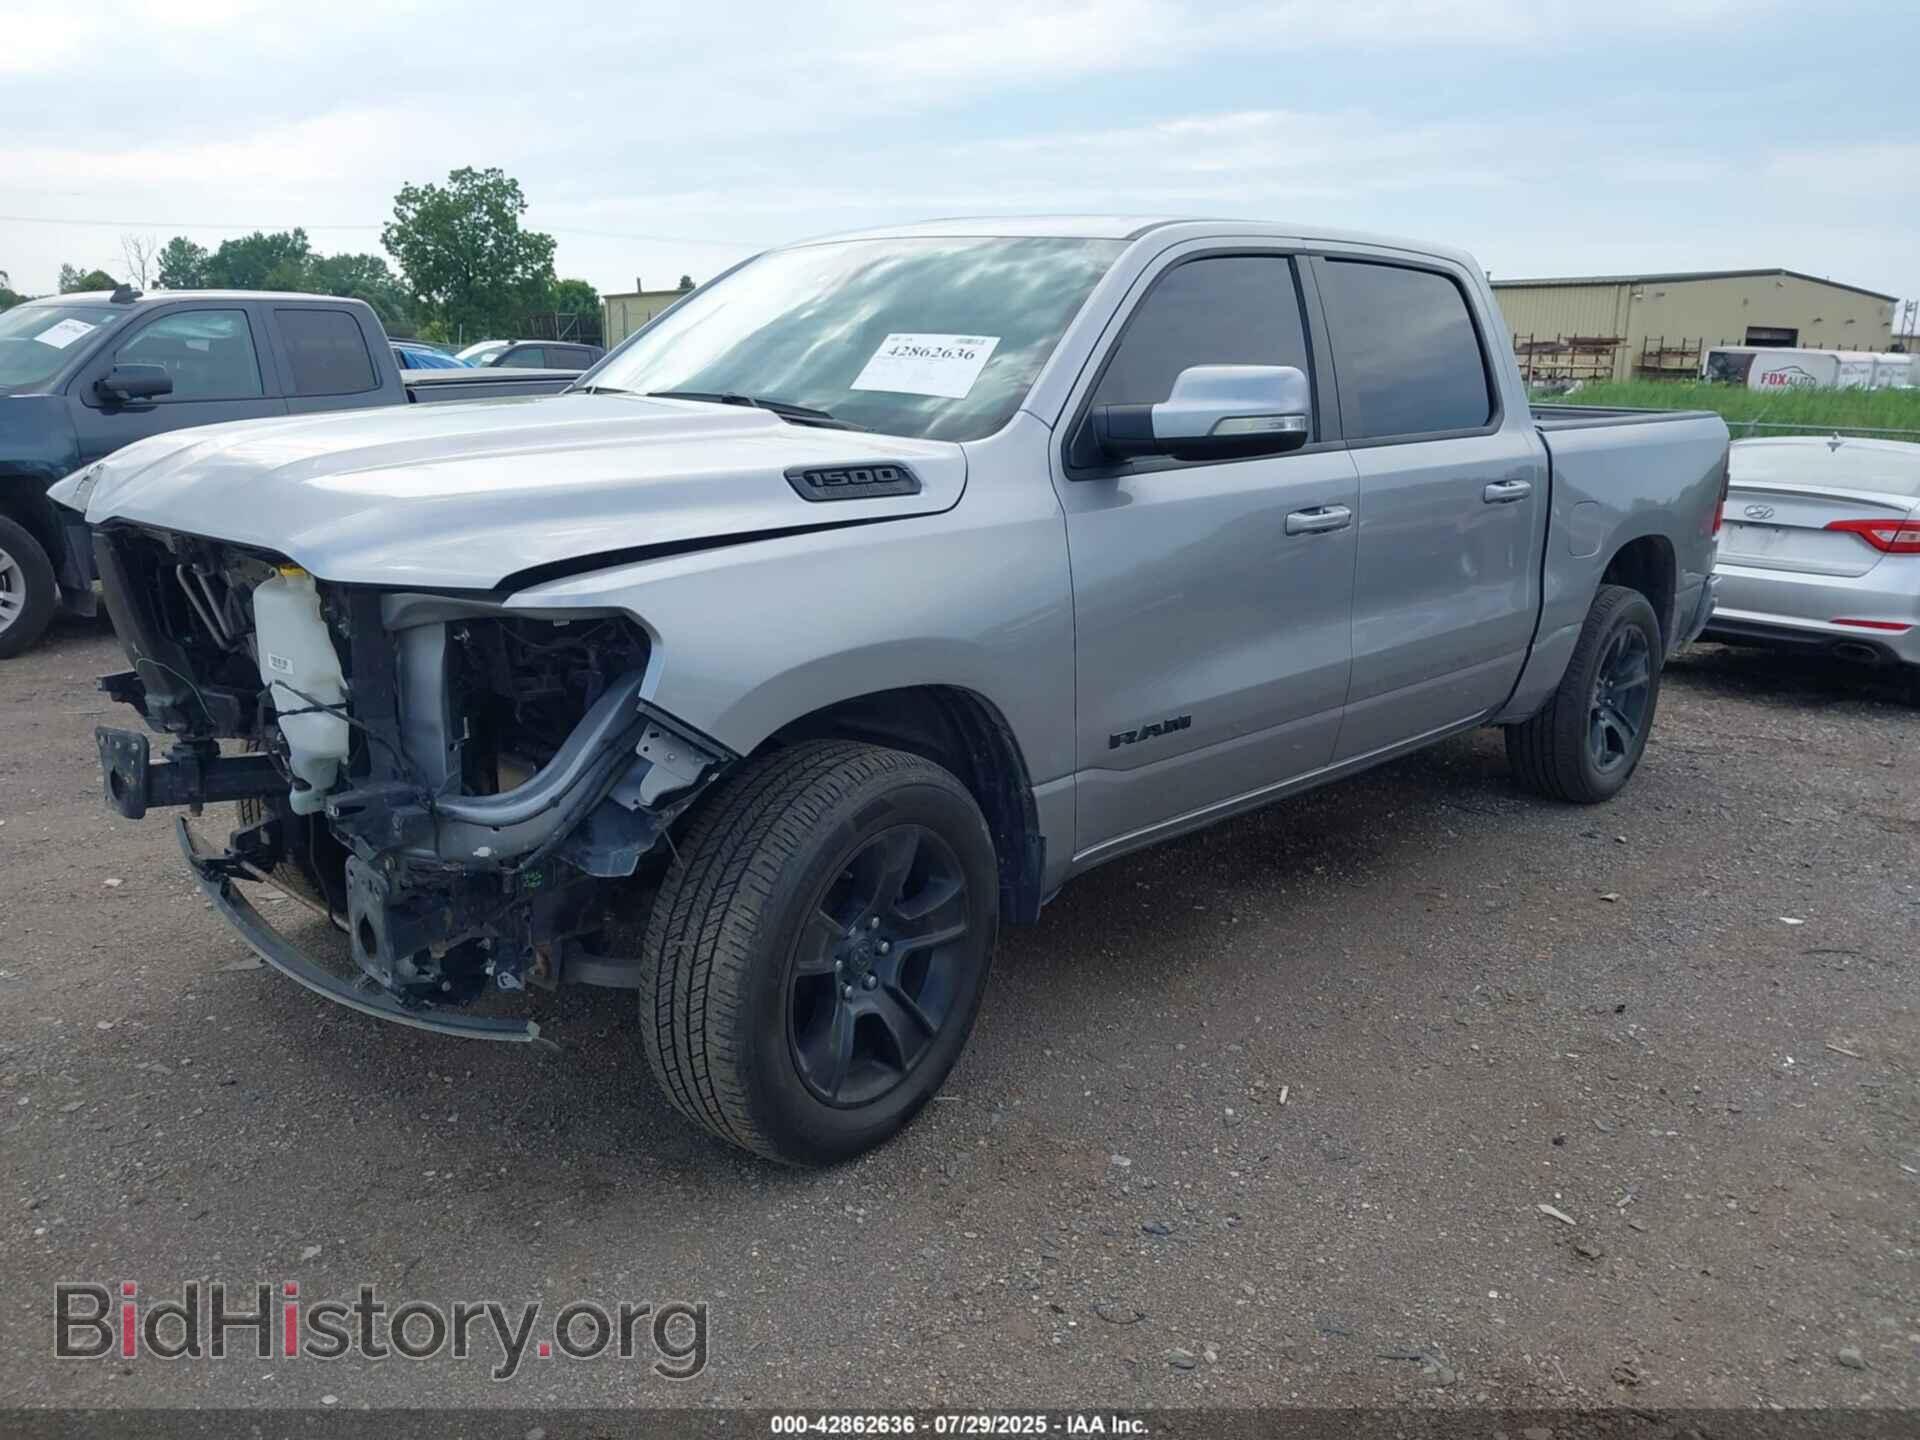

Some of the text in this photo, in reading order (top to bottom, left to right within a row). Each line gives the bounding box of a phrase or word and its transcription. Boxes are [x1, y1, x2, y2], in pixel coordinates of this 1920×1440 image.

[887, 345, 976, 361] 42862636
[806, 467, 899, 487] 1500
[1108, 715, 1192, 750] RAM
